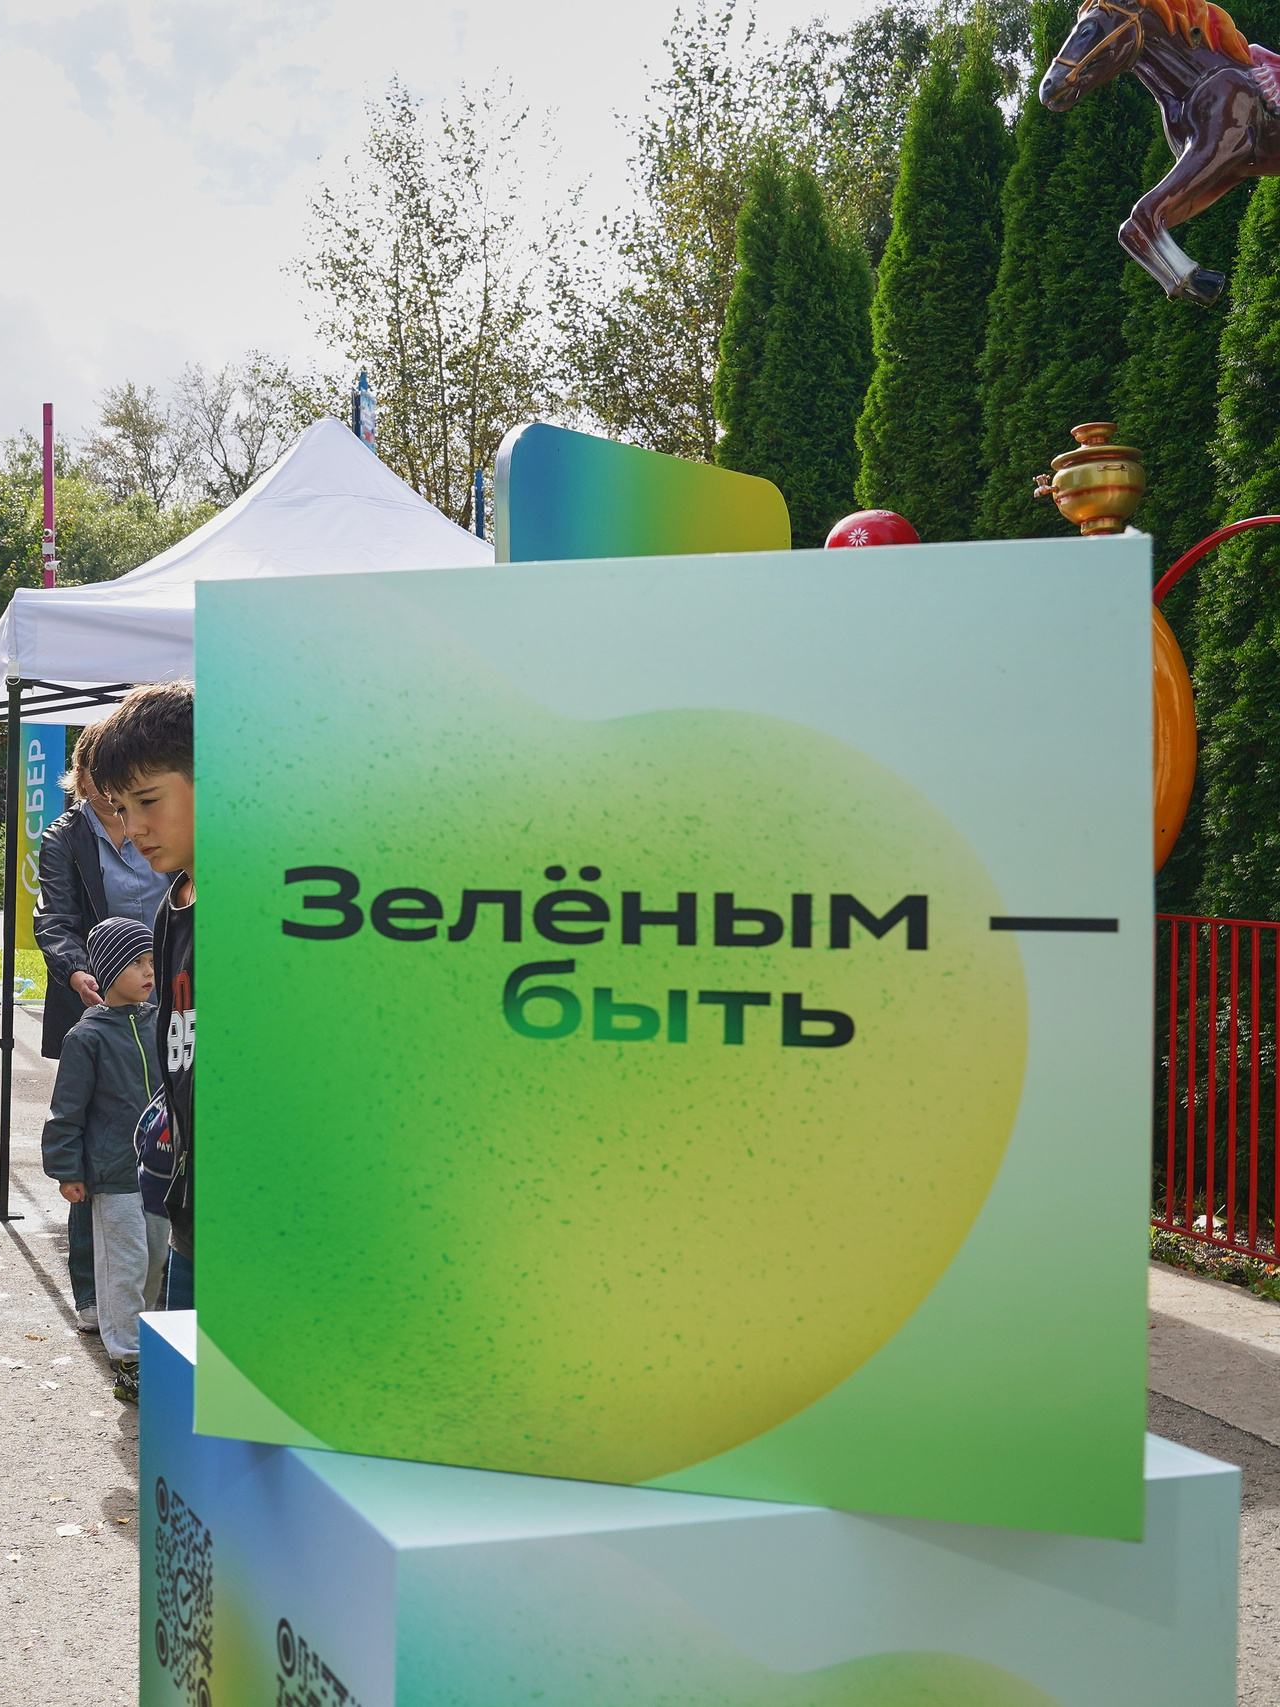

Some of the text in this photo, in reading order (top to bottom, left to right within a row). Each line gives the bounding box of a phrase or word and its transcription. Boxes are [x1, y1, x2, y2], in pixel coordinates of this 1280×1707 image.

[25, 739, 46, 840] СБЕР
[281, 864, 929, 951] Зелёным
[502, 957, 857, 1049] быть
